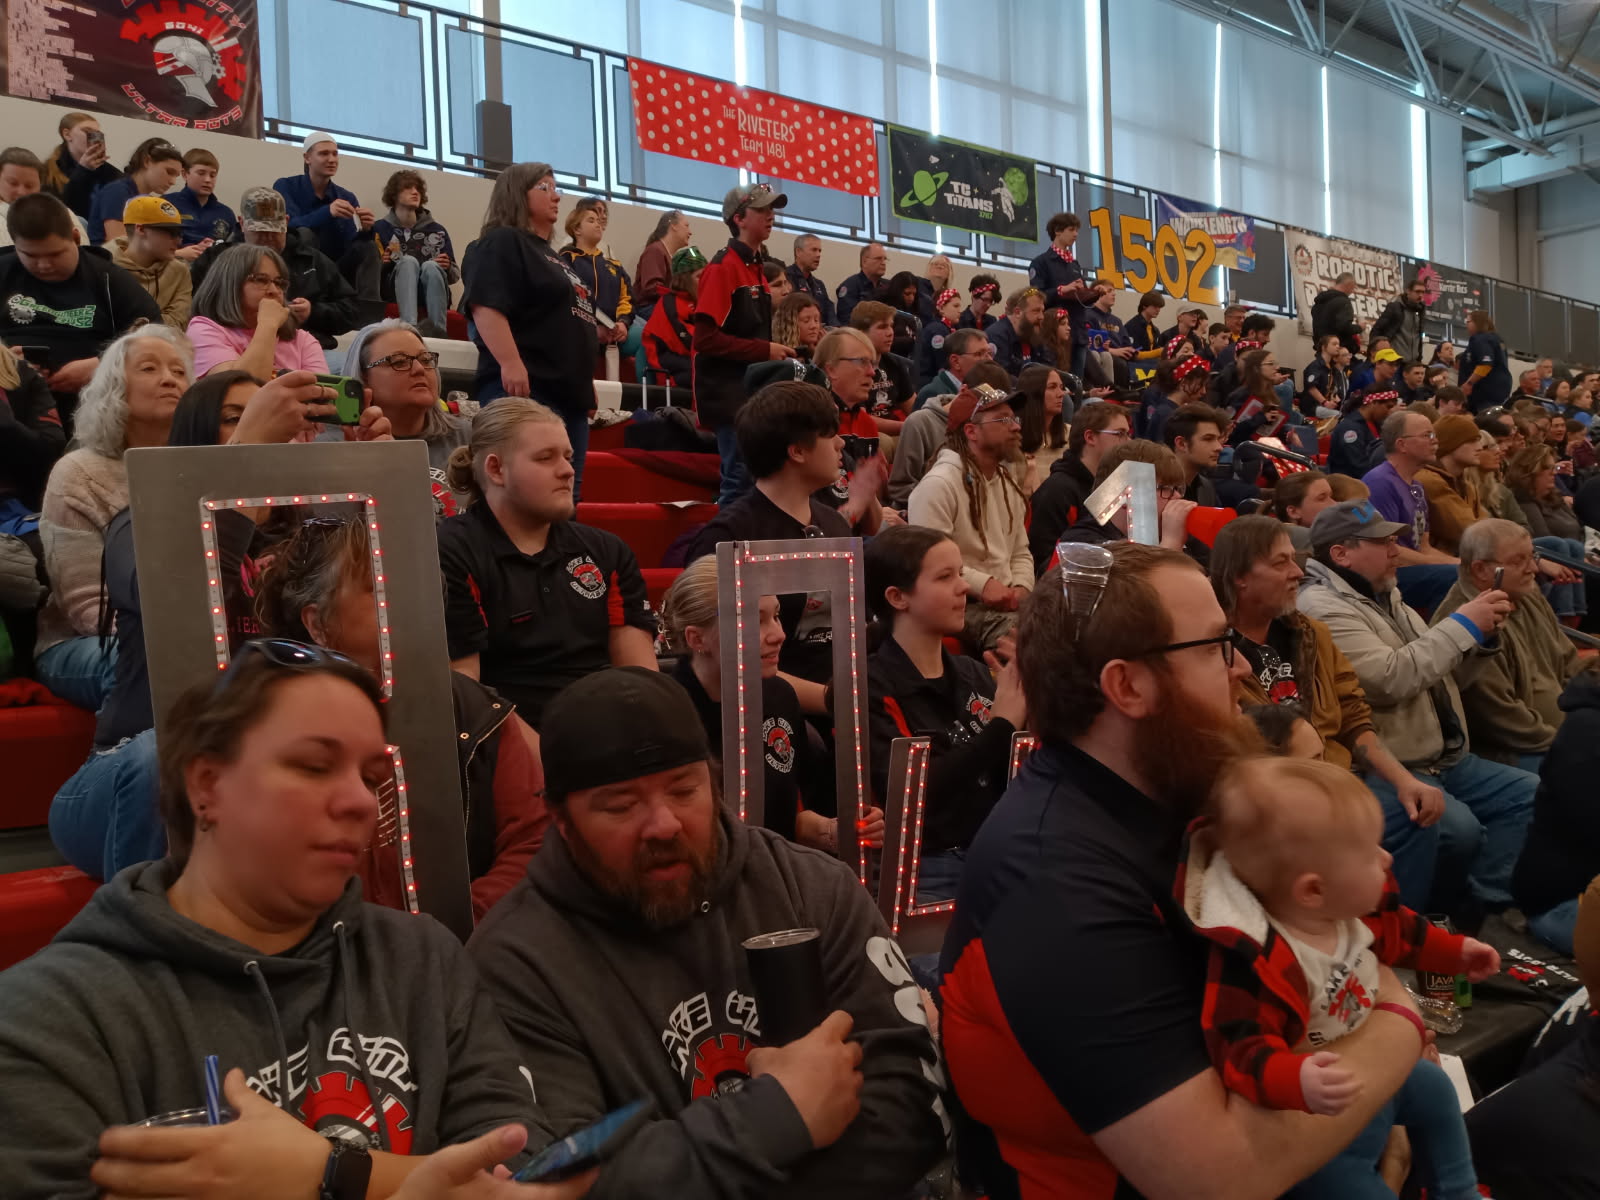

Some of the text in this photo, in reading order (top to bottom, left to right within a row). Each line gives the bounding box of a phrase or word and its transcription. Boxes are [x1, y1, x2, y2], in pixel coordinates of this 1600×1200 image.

[722, 105, 796, 143] THE RIVETERS
[739, 135, 786, 159] TEAM 1481
[950, 181, 971, 197] TC
[1089, 207, 1222, 306] 1502
[1316, 251, 1396, 293] ROBOTIC
